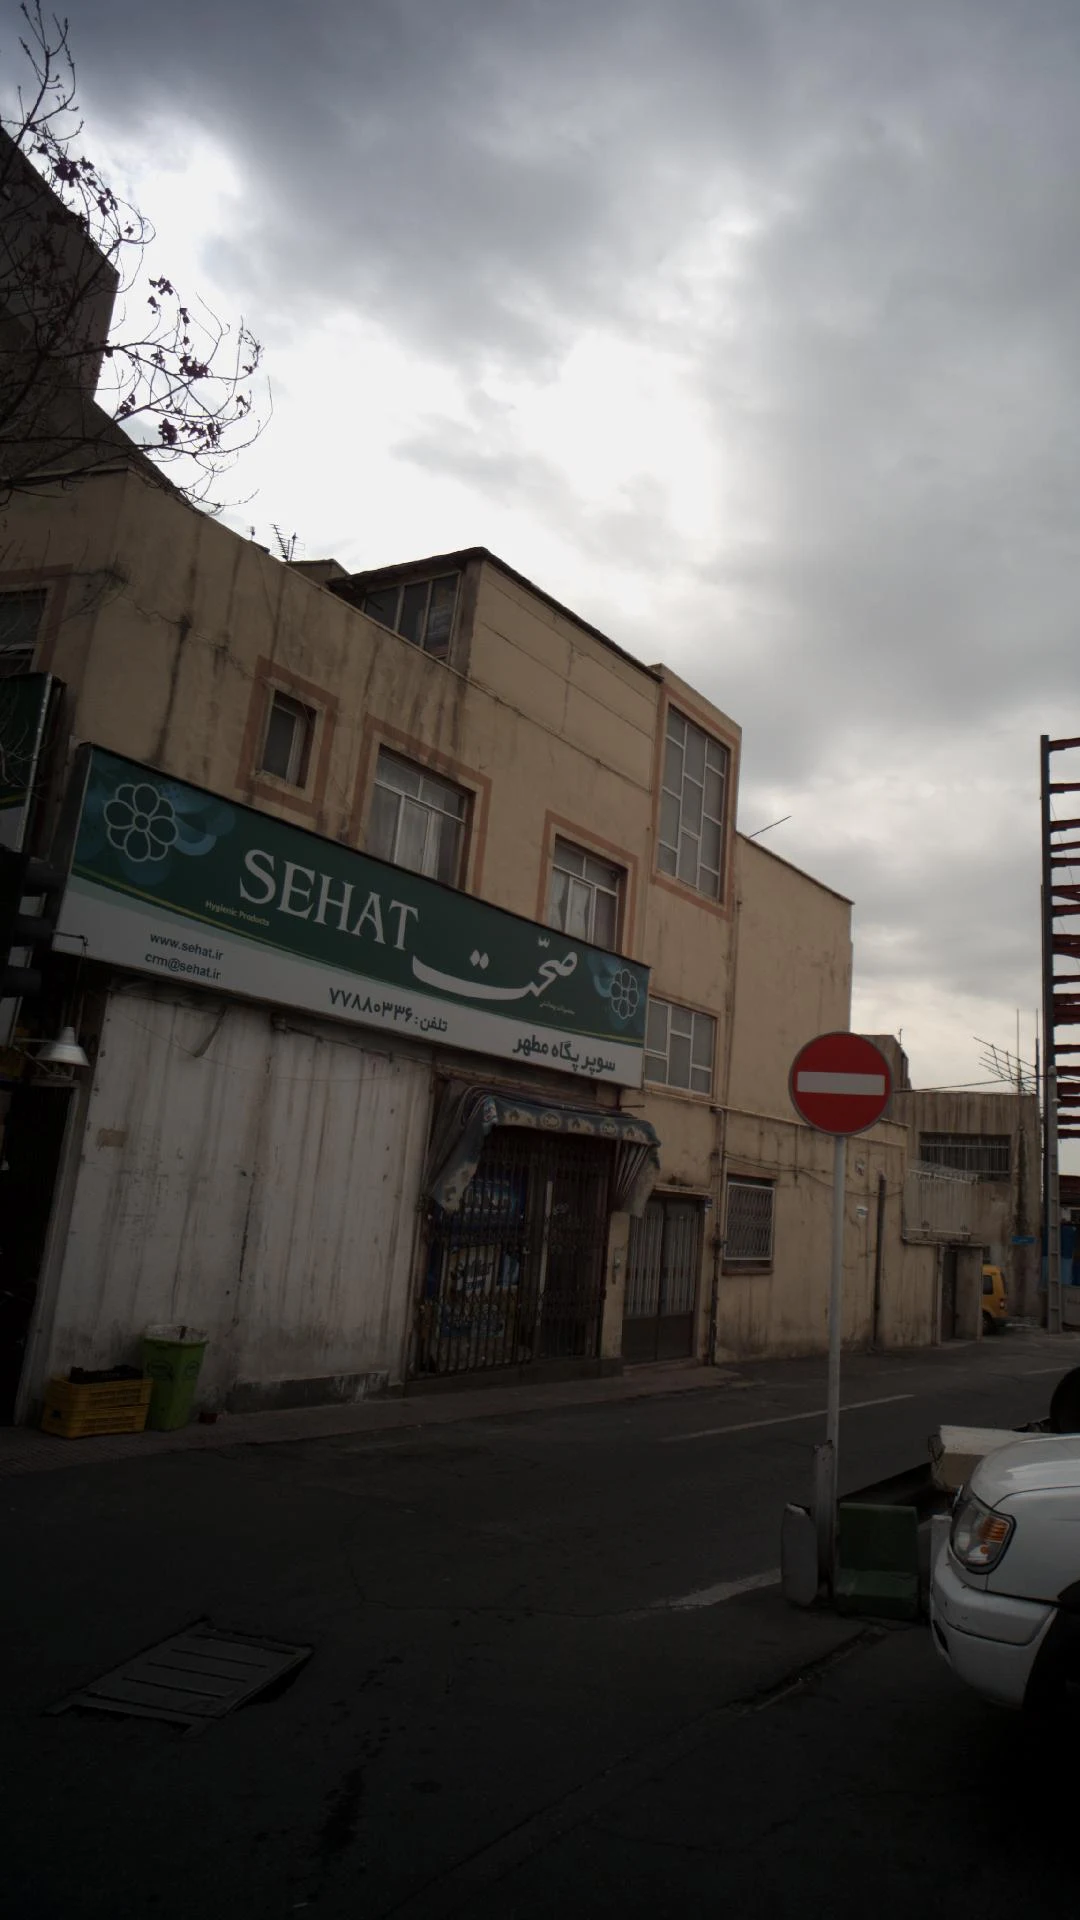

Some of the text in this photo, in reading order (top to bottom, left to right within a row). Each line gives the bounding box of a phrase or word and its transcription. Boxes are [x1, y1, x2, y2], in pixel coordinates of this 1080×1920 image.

[205, 900, 270, 927] Hygienic Products
[239, 849, 419, 951] SEHAT
[150, 933, 224, 961] www.sehat.ir
[145, 953, 222, 980] crm@sehat.ir
[512, 1034, 616, 1076] سوپر پگاه مطهر
